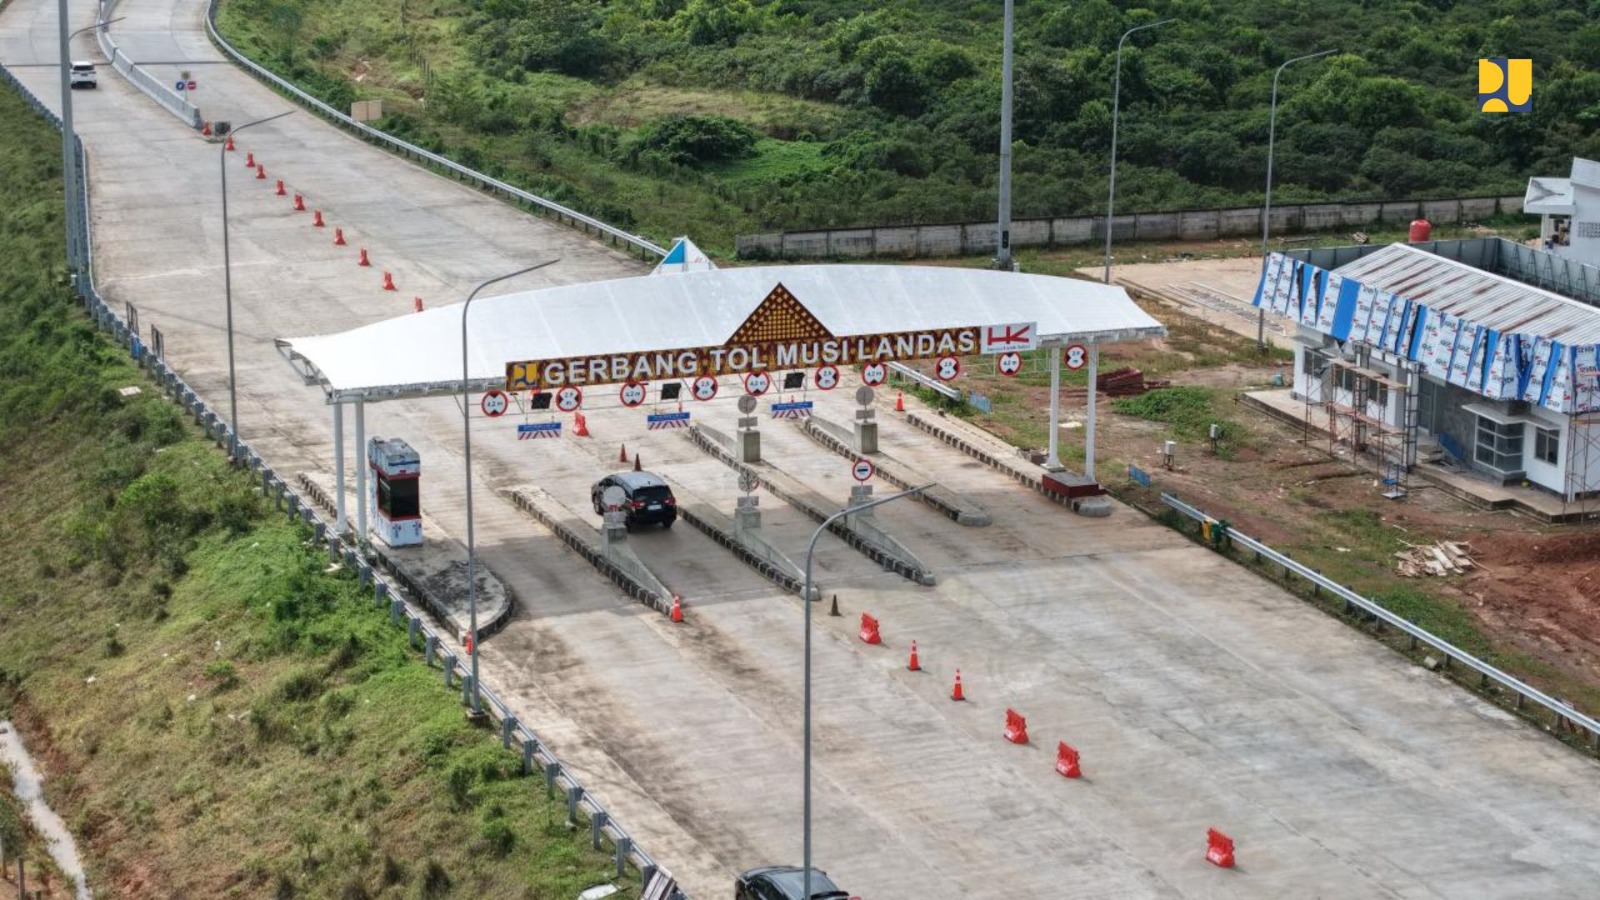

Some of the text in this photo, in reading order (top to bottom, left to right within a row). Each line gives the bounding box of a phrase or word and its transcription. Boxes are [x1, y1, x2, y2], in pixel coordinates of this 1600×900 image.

[544, 331, 974, 384] GERBANG TOL MUSI LANDAS
